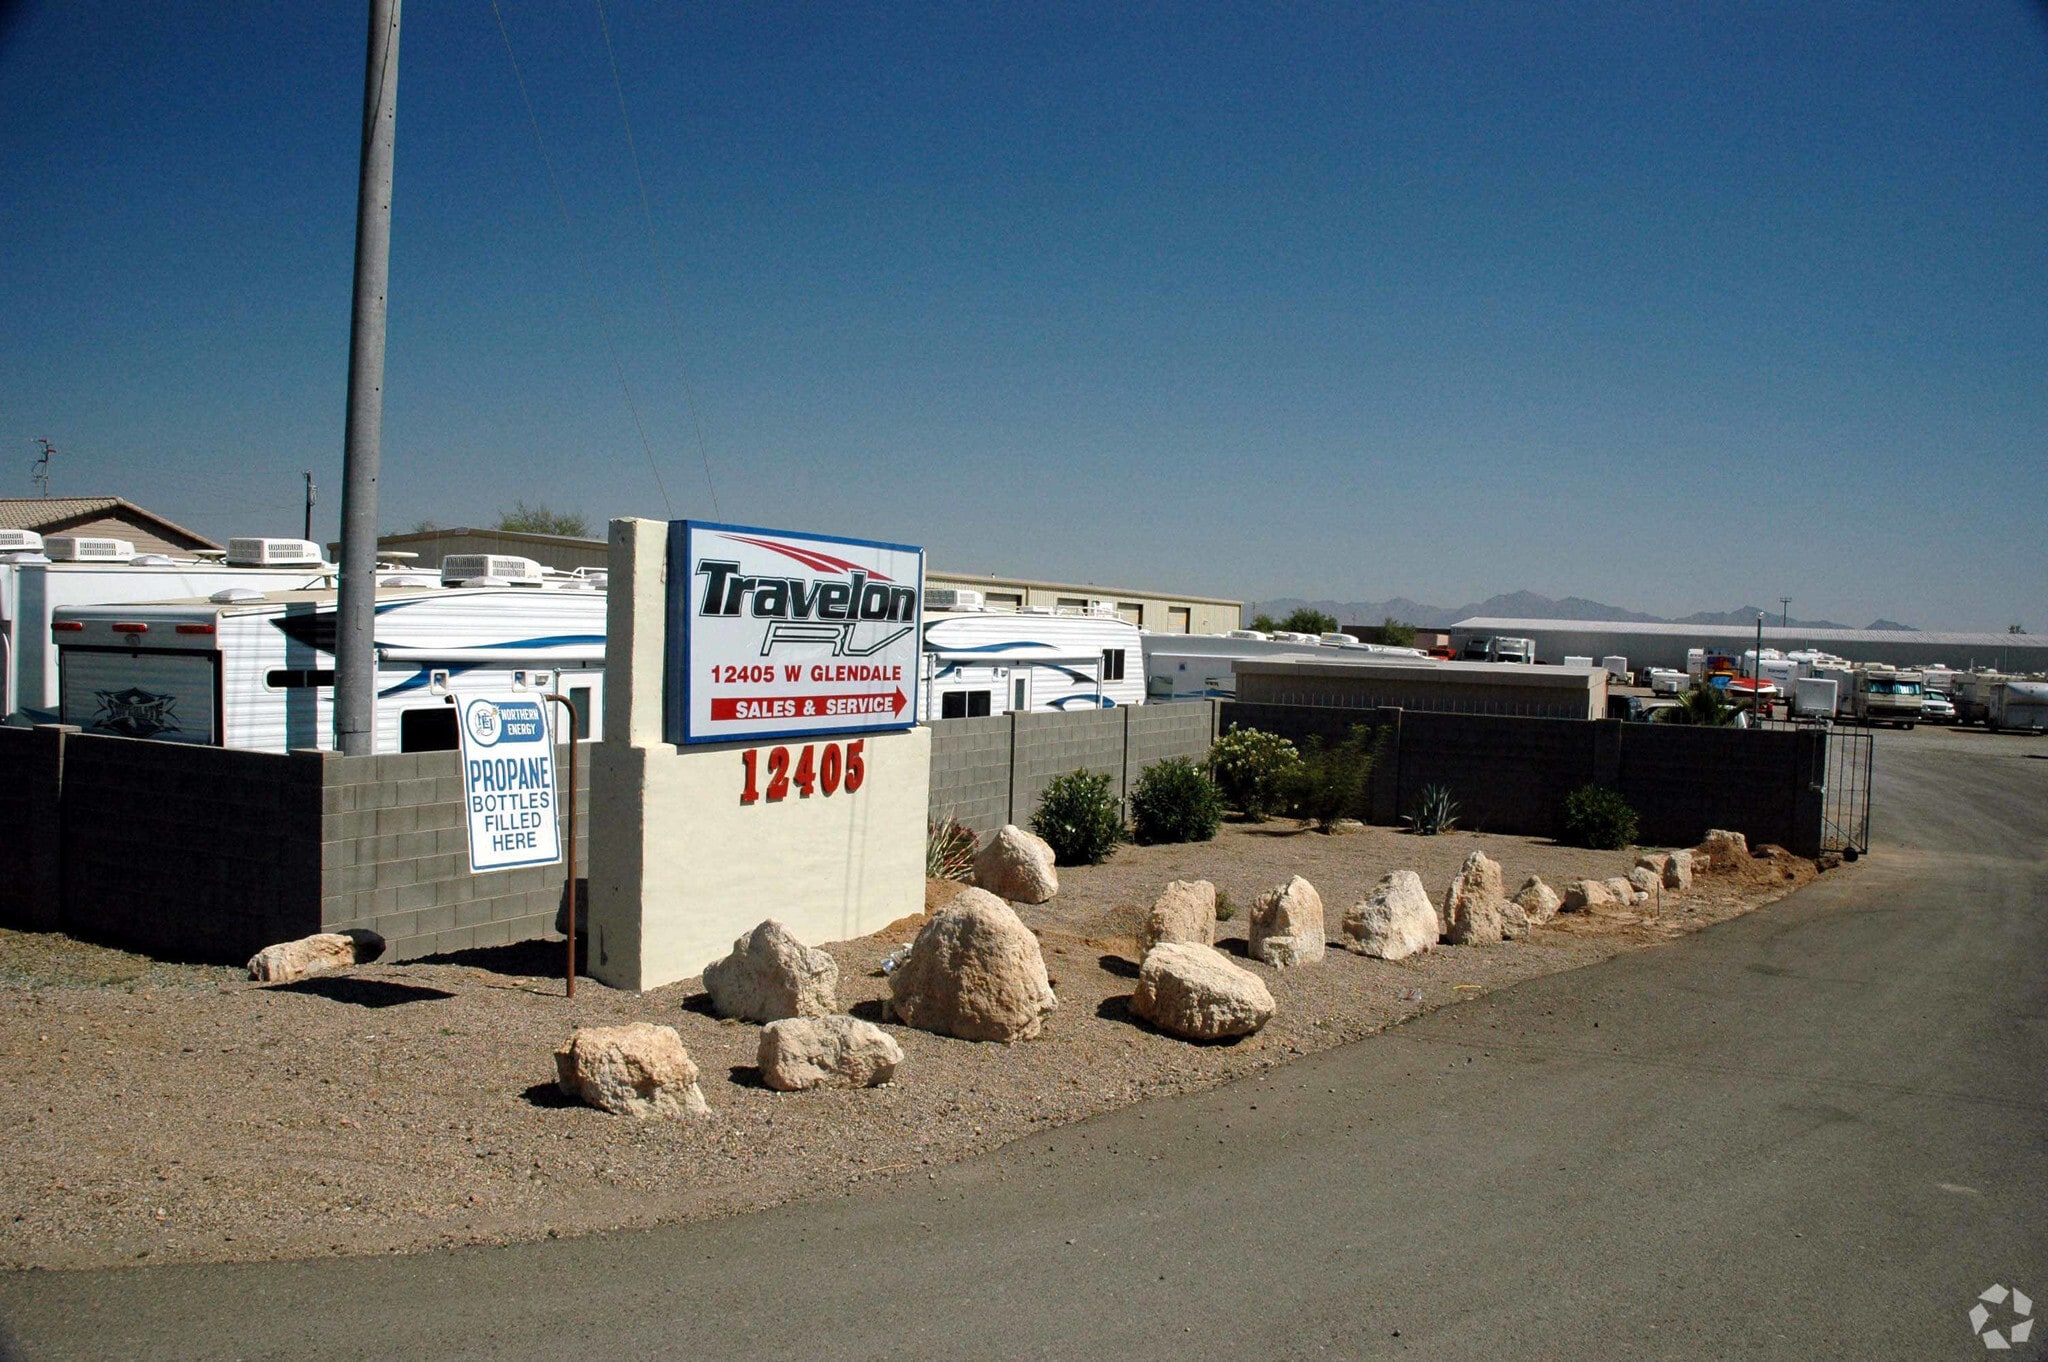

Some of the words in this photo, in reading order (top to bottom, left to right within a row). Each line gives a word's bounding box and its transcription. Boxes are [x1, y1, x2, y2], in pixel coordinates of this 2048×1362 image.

[695, 558, 917, 623] Travelon
[760, 620, 915, 657] RV
[711, 664, 775, 683] 12405
[784, 664, 802, 682] W
[811, 665, 902, 682] GLENDALE
[501, 708, 539, 720] NORTHERN
[736, 700, 796, 719] SALES
[803, 699, 816, 716] &
[826, 696, 894, 715] SERVICE
[507, 723, 536, 735] ENERGY
[470, 756, 550, 793] PROPANE
[741, 739, 865, 804] 12405
[472, 791, 550, 813] BOTTLES
[485, 812, 542, 832] FILLED
[493, 831, 537, 852] HERE
